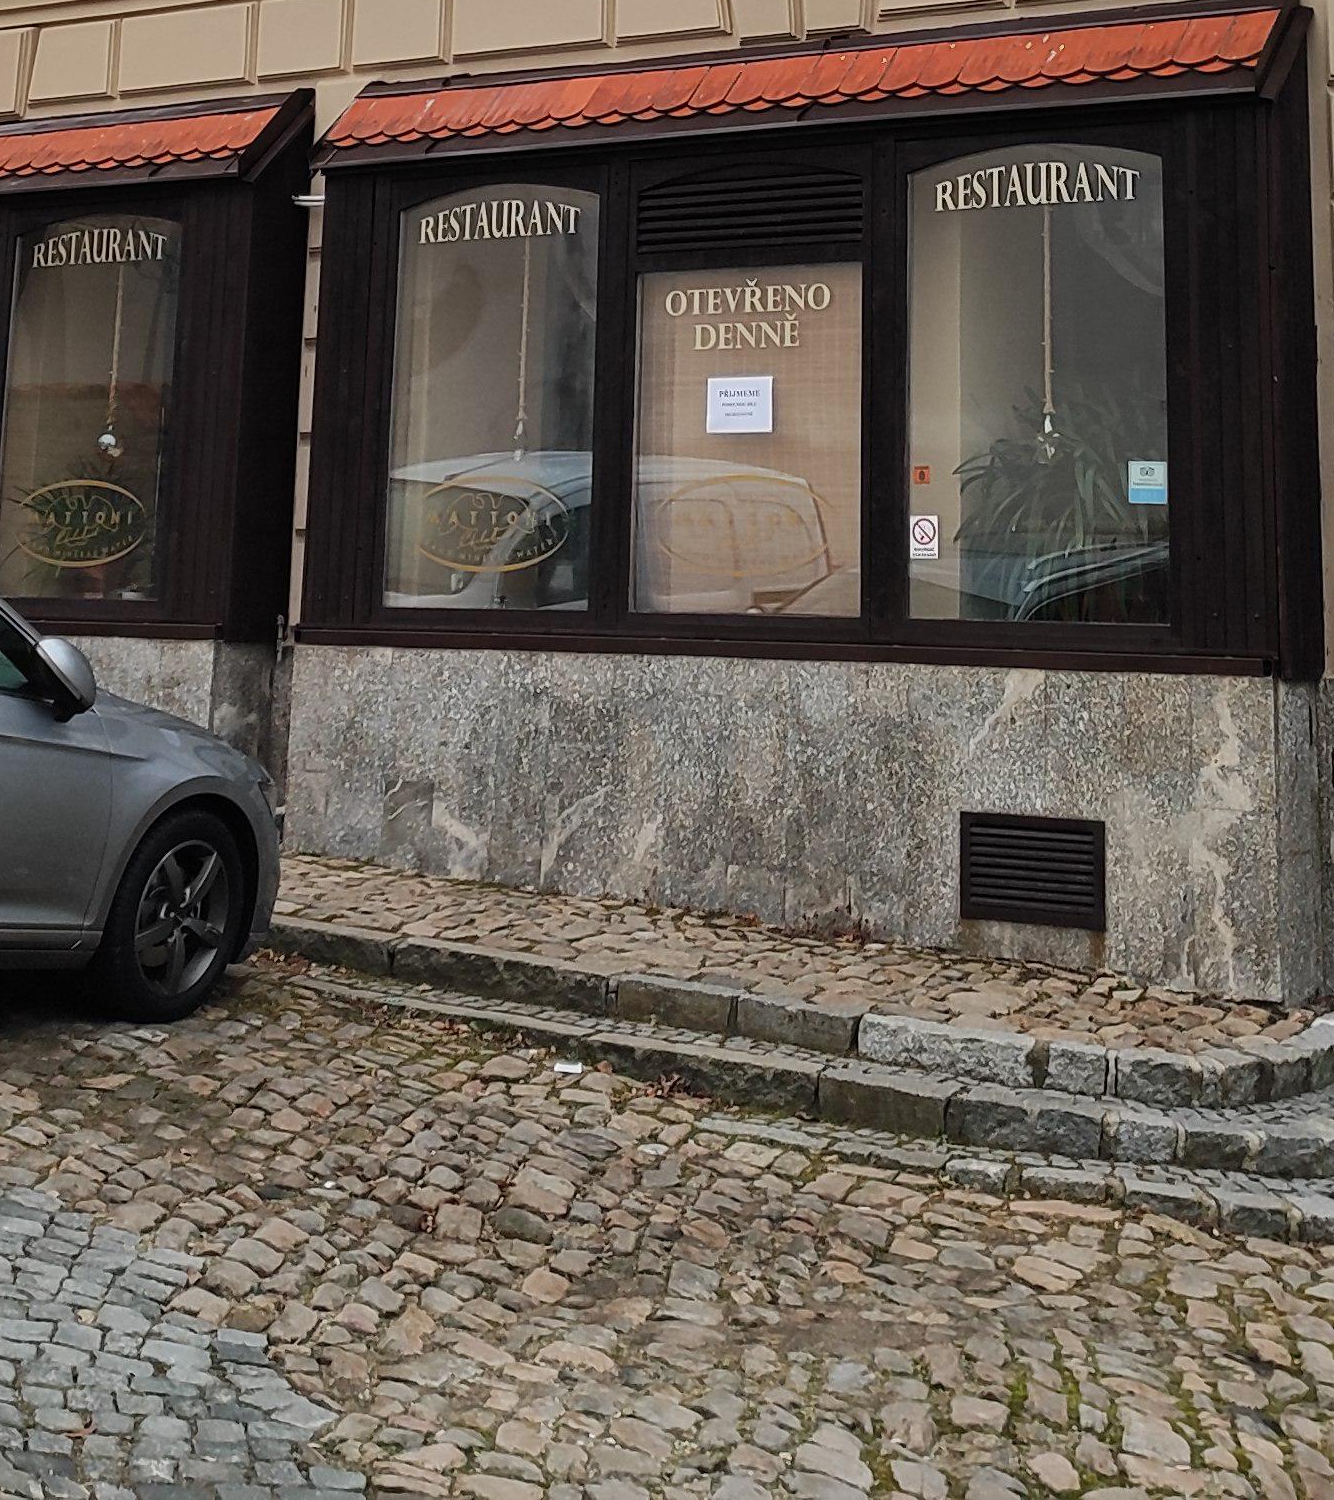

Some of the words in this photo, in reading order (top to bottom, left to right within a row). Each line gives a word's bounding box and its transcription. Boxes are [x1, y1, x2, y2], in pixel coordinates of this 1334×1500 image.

[933, 160, 1142, 213] RESTAURANT
[418, 199, 582, 245] RESTAURANT
[31, 227, 168, 269] RESTAURANT
[665, 277, 832, 317] OTEVŘENO
[693, 313, 800, 351] DENNĚ
